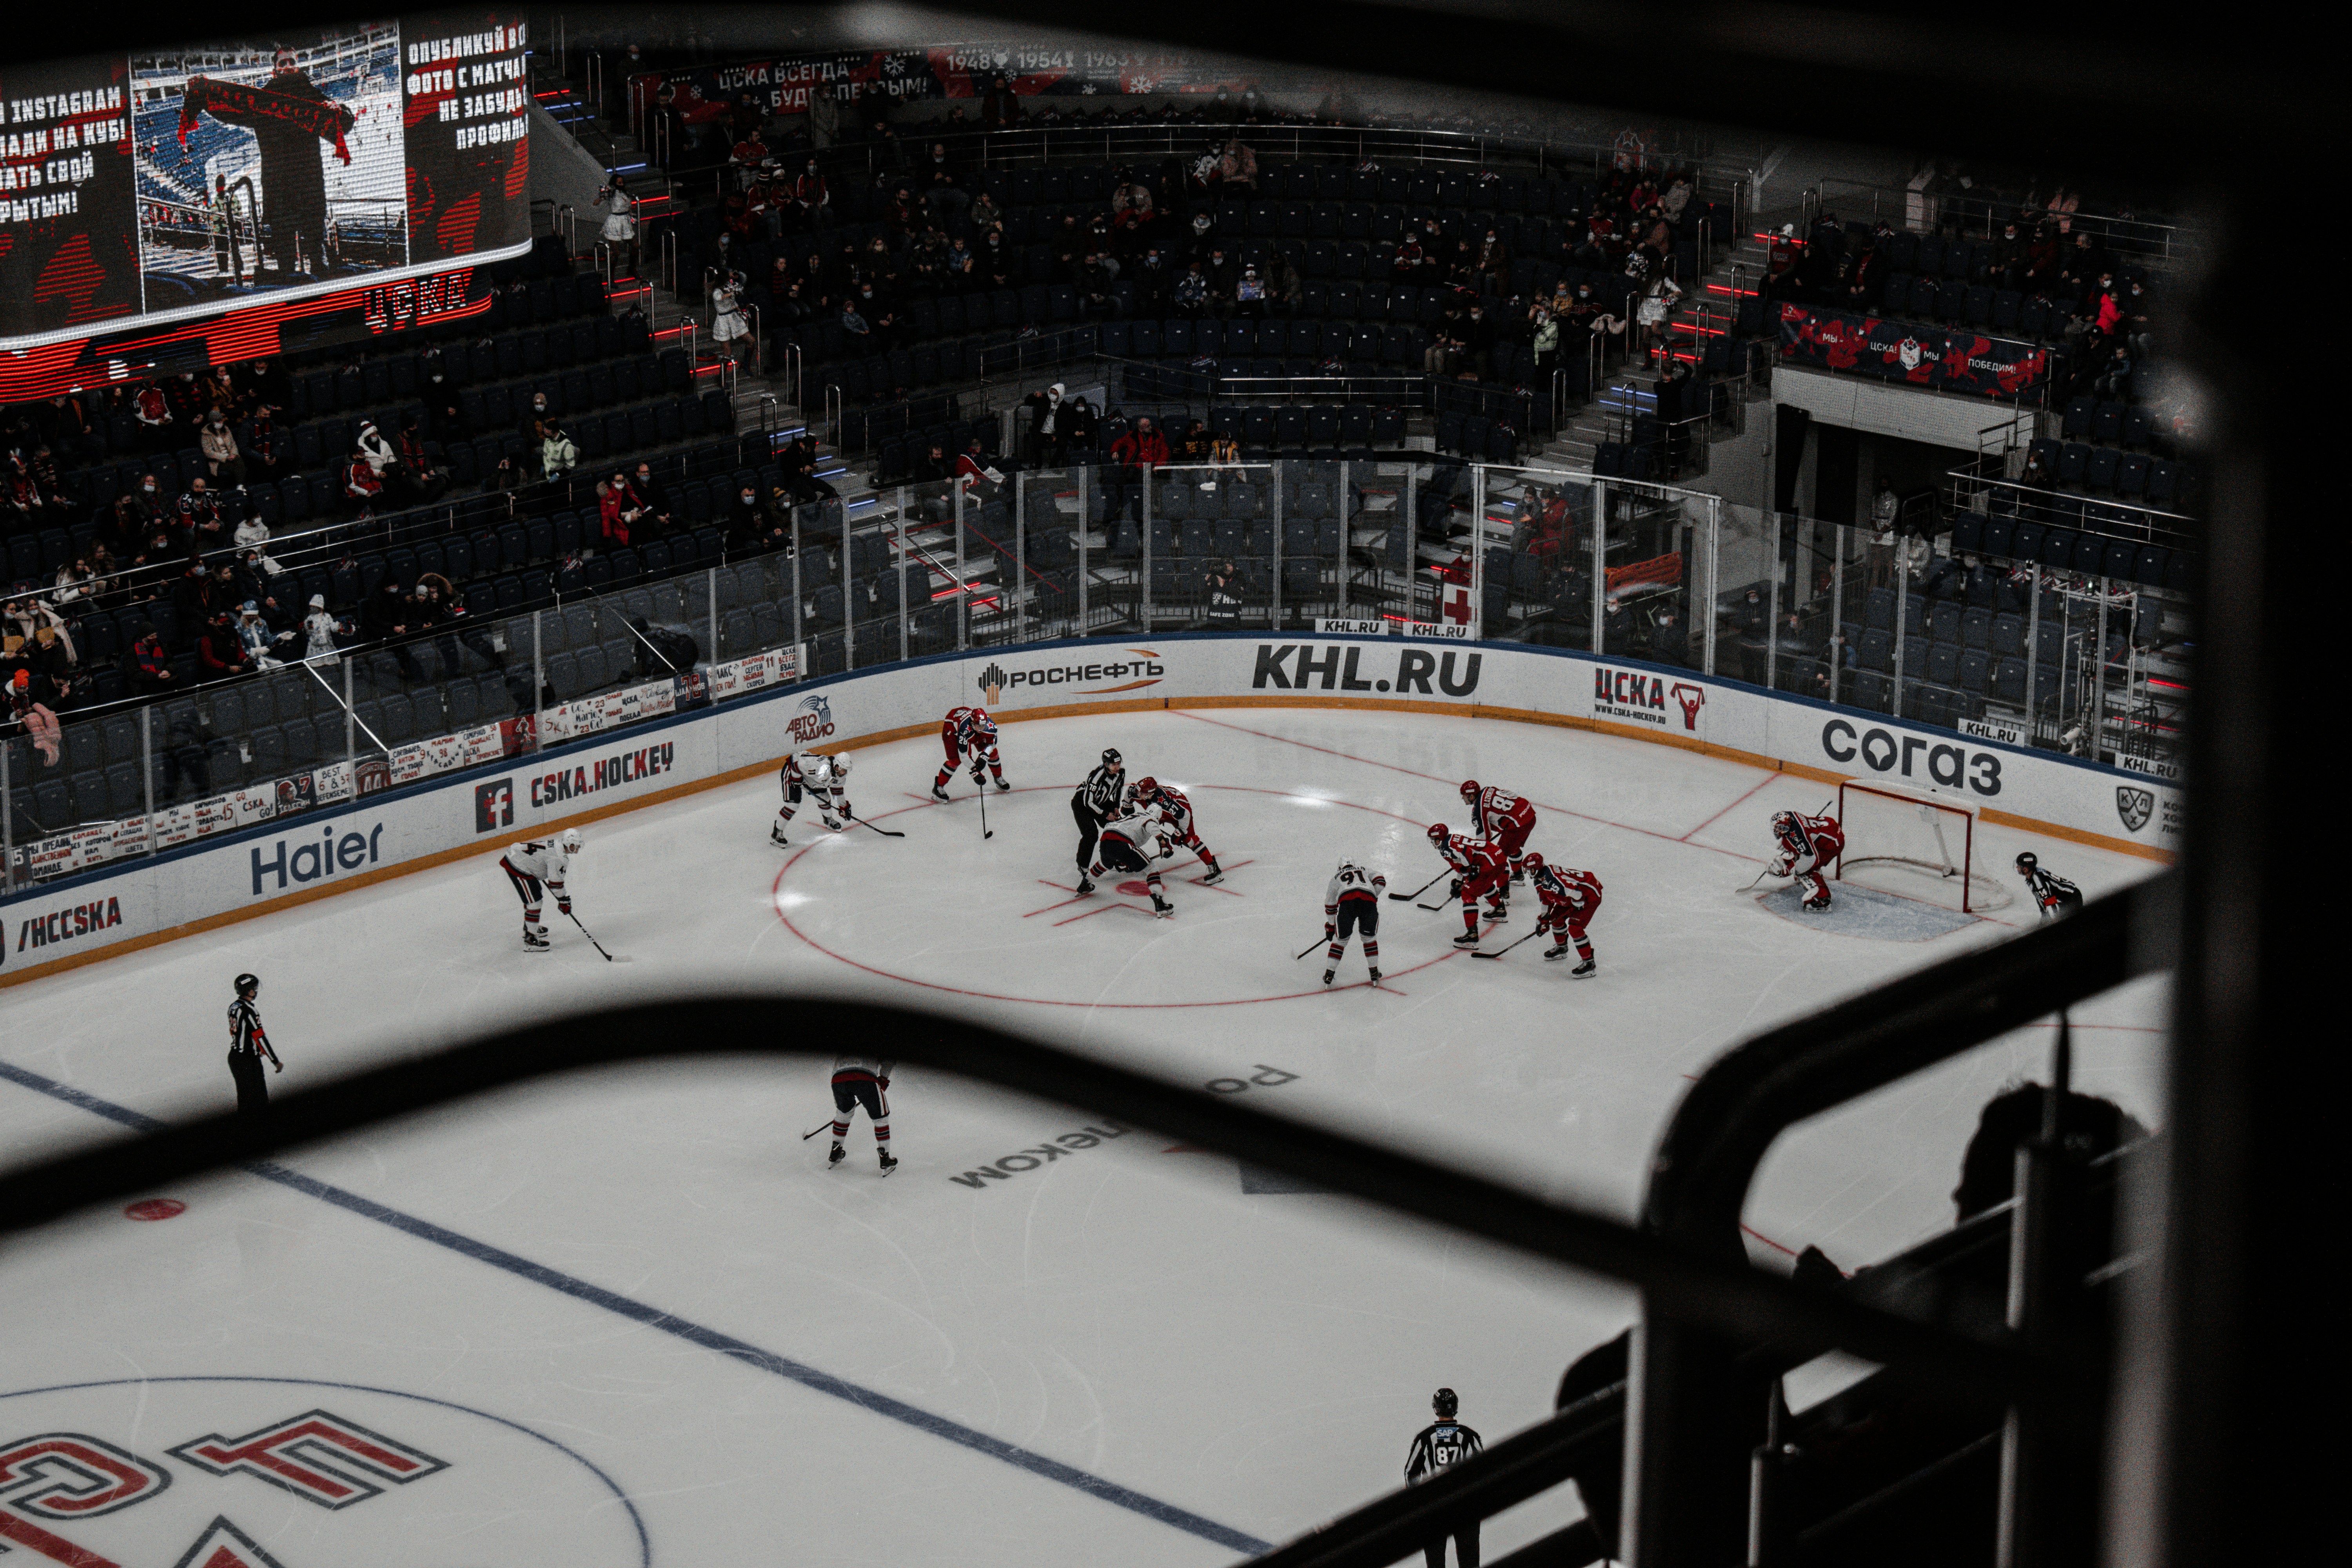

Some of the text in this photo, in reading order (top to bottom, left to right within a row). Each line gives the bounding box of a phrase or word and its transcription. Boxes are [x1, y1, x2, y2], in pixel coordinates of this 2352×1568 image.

[408, 25, 505, 65] ОПУБЛИКУЙ
[508, 27, 516, 49] В
[946, 55, 991, 71] 1948
[1017, 51, 1062, 69] 1954
[407, 57, 521, 95] ФОТО С МАТЧА
[719, 62, 849, 91] ЦСКА ВСЕГДА
[11, 86, 121, 123] INSTAGRAM
[439, 87, 522, 122] НЕ ЗАБУДЬ
[53, 125, 78, 150] НА
[83, 118, 126, 145] КУБ!
[456, 117, 525, 150] ПРОФИЛЬ
[46, 150, 94, 184] СВОЙ
[1822, 333, 1838, 343] МЫ
[1870, 341, 1897, 353] ЦСКА!
[1924, 350, 2016, 373] МЫ ПОБЕДИМ!
[1324, 620, 1379, 633] KHL.RU
[1412, 624, 1466, 638] KHL.RU
[745, 663, 763, 674] СЕРГЕЙ
[766, 656, 774, 668] 11
[1252, 644, 1482, 697] KHL.RU
[746, 677, 765, 688] СКОРЕЙ
[1010, 661, 1164, 688] РОСНЕФТЬ
[605, 692, 622, 701] ТОЛЬКО
[681, 673, 702, 701] 78
[1595, 667, 1665, 711] ЦСКА
[595, 700, 605, 708] 23
[619, 711, 641, 722] ПОБЕДА
[785, 714, 817, 733] АВТО
[1595, 704, 1666, 724] WWW.CSKA-HOCKEY.RU
[580, 725, 589, 733] 23
[795, 722, 835, 744] РАДИО
[1965, 722, 2016, 744] KHL.RU
[420, 749, 426, 760] 9
[439, 748, 448, 759] 98
[465, 746, 481, 757] ЦСКА
[322, 766, 341, 779] BEST
[532, 741, 673, 808] CSKA.HOCKEY
[2123, 757, 2176, 779] KHL.RU
[299, 775, 311, 794] 7
[319, 780, 325, 791] 6
[331, 778, 338, 789] &
[1089, 783, 1098, 792] 78
[223, 803, 233, 821] 15
[260, 803, 273, 818] GO!
[1169, 804, 1179, 816] 27
[251, 822, 383, 895] Haier
[1340, 870, 1366, 885] 91
[1550, 884, 1560, 894] 35
[1437, 1429, 1453, 1437] SAP
[1436, 1446, 1459, 1465] 87
